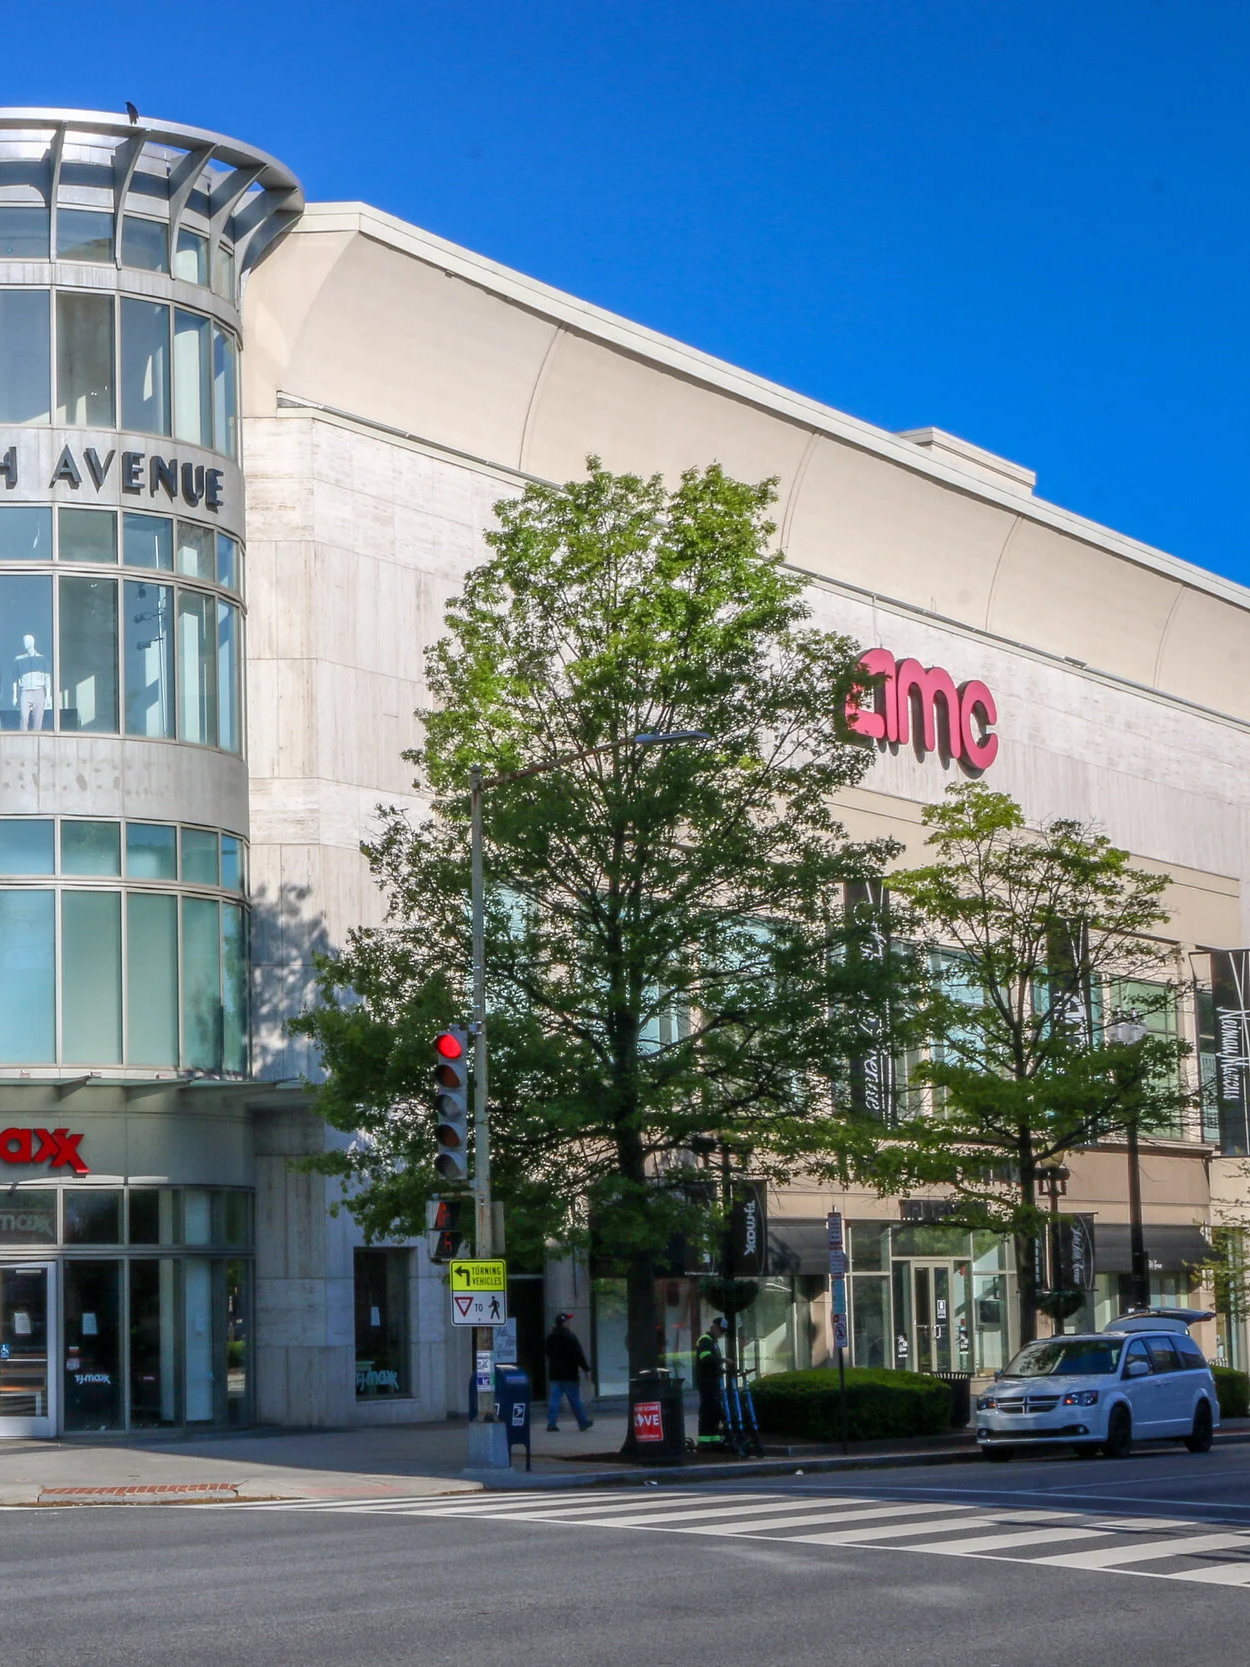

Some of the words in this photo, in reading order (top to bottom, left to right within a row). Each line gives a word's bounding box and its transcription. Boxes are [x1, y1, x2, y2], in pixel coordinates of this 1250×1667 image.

[50, 444, 224, 512] AVENUE
[471, 1266, 502, 1276] TURNING
[471, 1276, 502, 1286] VEHICLES
[474, 1303, 483, 1312] TO
